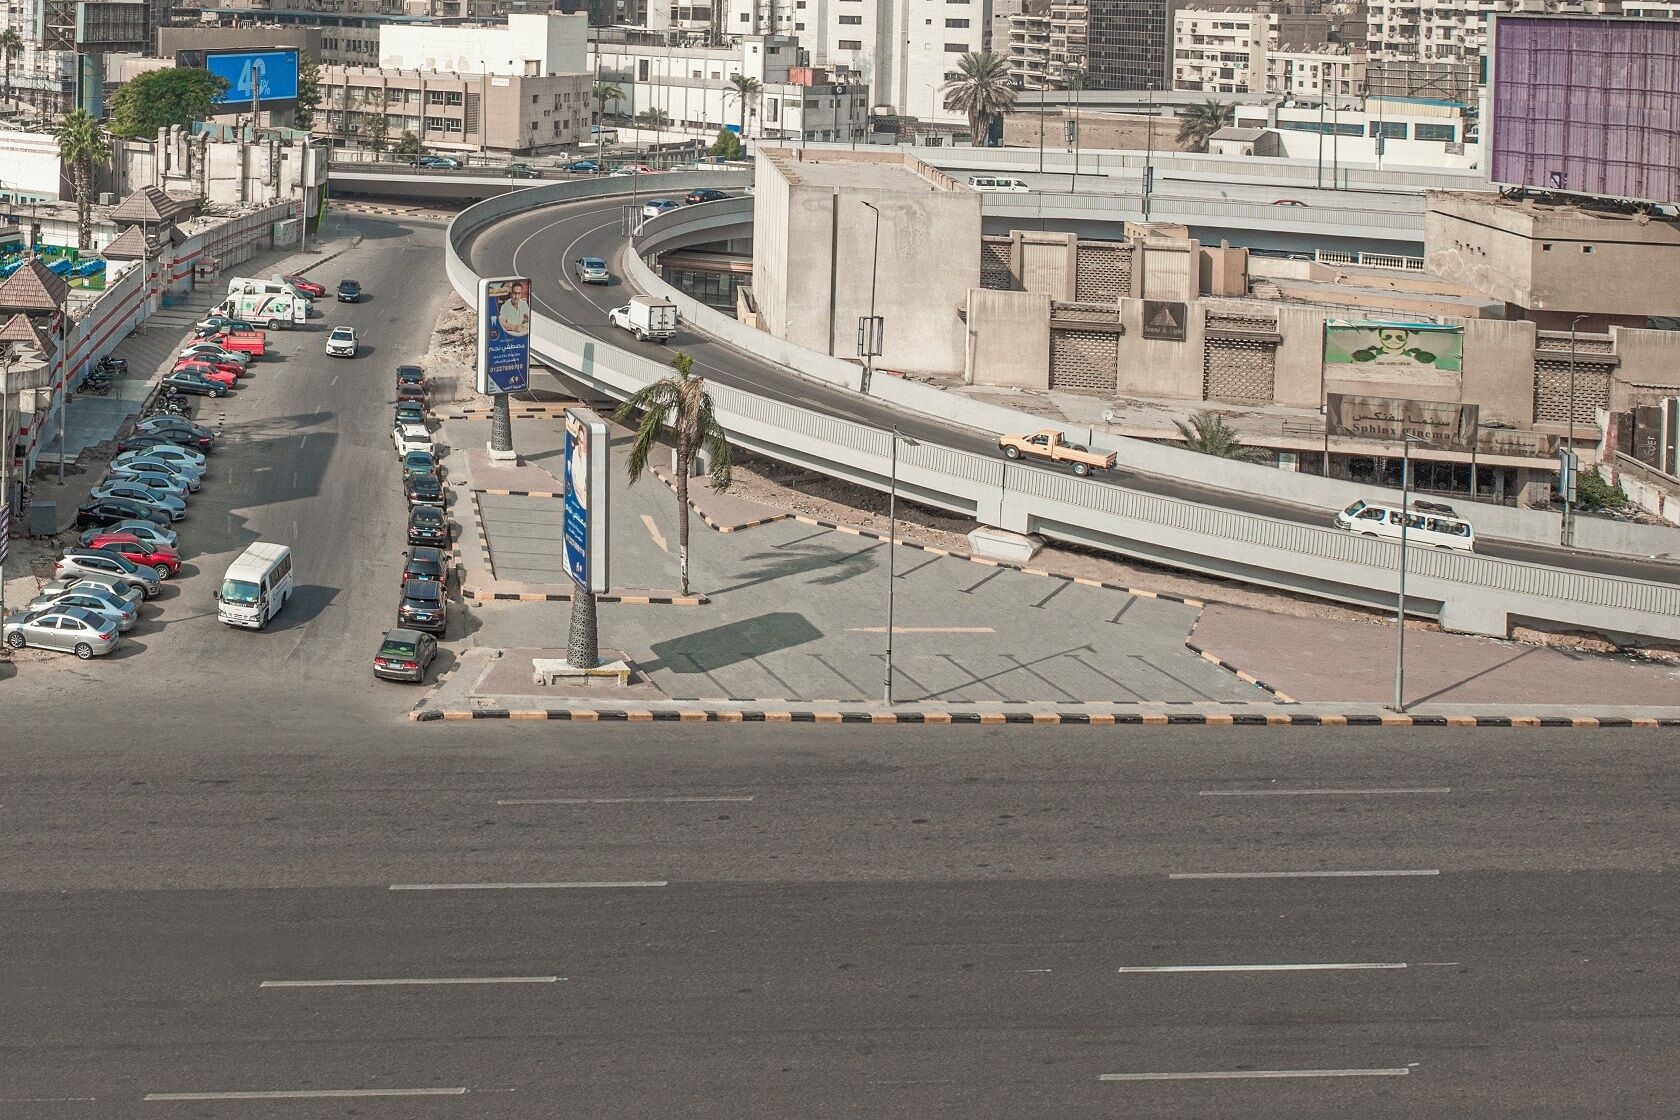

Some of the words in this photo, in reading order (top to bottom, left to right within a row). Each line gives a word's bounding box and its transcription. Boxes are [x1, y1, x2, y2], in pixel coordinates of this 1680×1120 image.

[1352, 411, 1405, 423] سفنكس
[1408, 415, 1450, 428] سينما
[1352, 423, 1396, 436] Sphinx
[1402, 427, 1451, 440] Cinema
